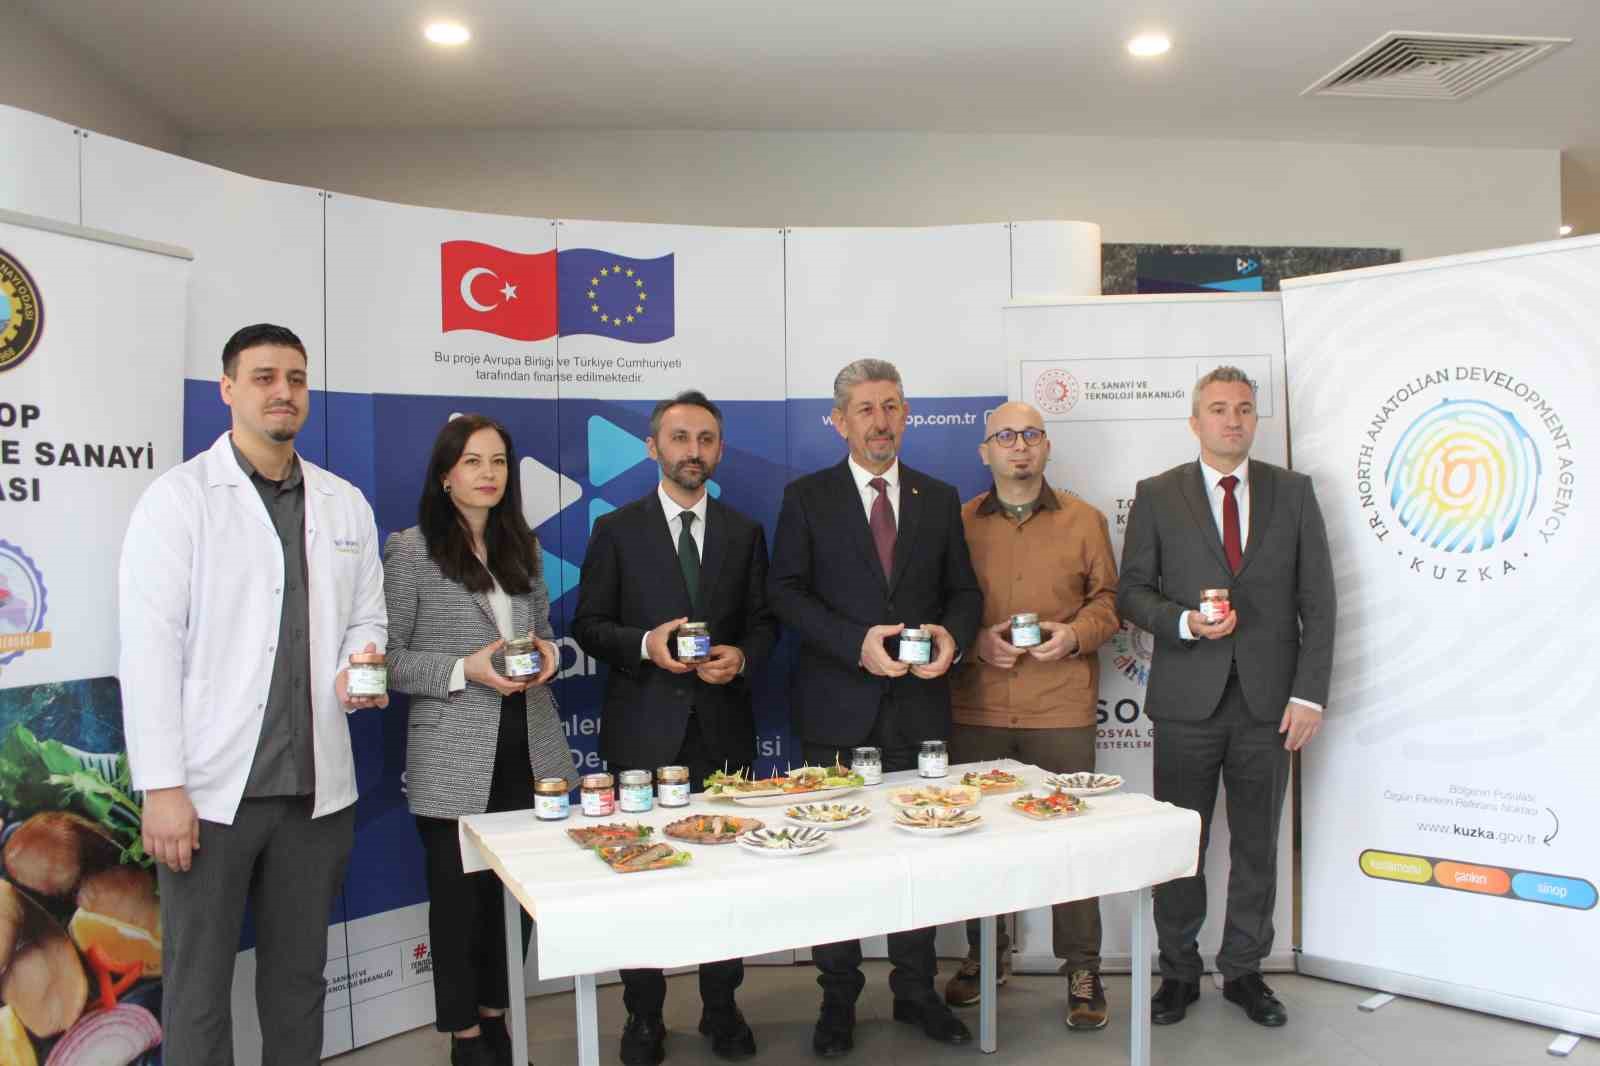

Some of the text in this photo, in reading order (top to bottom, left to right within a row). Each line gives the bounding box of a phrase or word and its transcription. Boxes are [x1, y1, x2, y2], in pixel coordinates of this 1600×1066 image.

[434, 351, 450, 362] Bu
[453, 353, 481, 367] proje
[483, 354, 521, 367] Avrupa
[557, 358, 570, 367] ve
[573, 355, 613, 370] Türkiye
[616, 357, 682, 370] Cumhuriyeti
[476, 369, 530, 382] tarafından
[533, 371, 573, 382] finanse
[1084, 380, 1148, 390] T.C. SANAYİ VE
[1085, 389, 1185, 400] TEKNOLOJİ BAKANLIĞI
[35, 441, 154, 470] SANAYİ
[1357, 444, 1375, 509] NORTH
[1366, 367, 1450, 443] ANATOLIAN
[1455, 366, 1572, 452] DEVELOPMENT
[1537, 455, 1575, 543] AGENCY
[1416, 823, 1537, 845] www.kuzka.gov.tr
[1536, 882, 1568, 899] sinop
